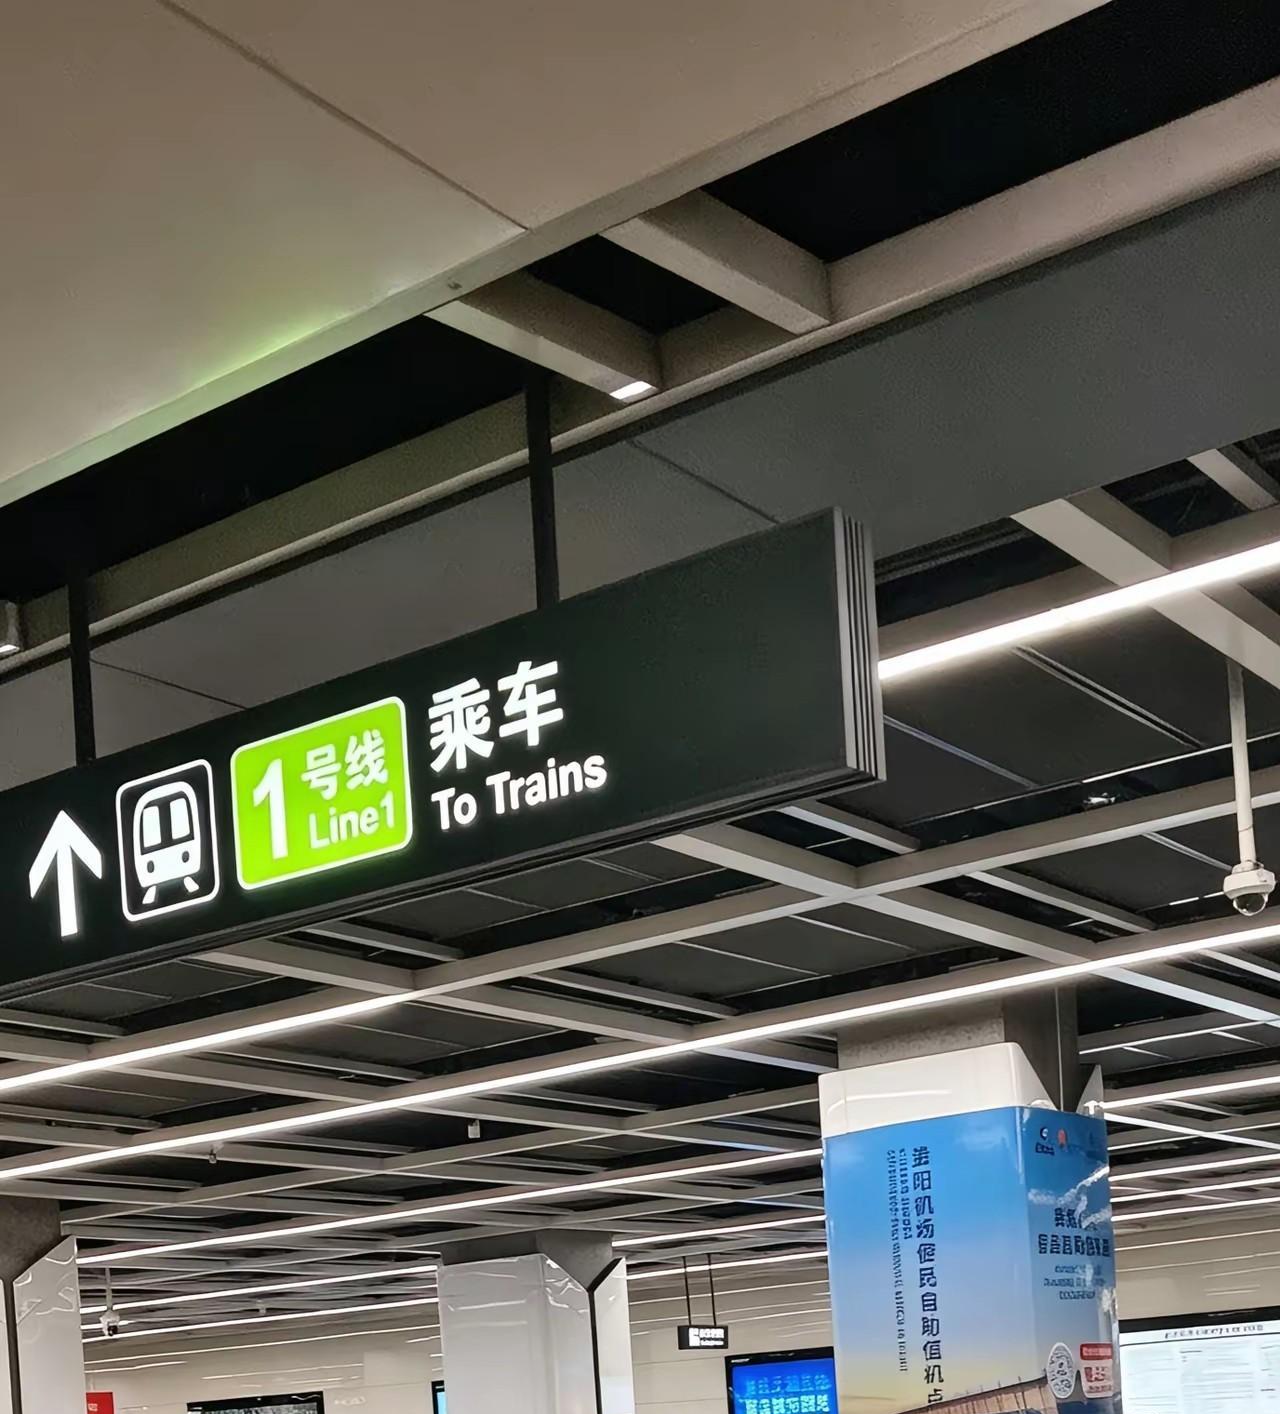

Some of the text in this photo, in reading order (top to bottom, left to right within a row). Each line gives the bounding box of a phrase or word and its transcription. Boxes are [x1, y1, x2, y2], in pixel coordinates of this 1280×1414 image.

[428, 660, 564, 773] 乘车
[253, 729, 390, 859] 1 号线
[430, 754, 608, 831] To Trains
